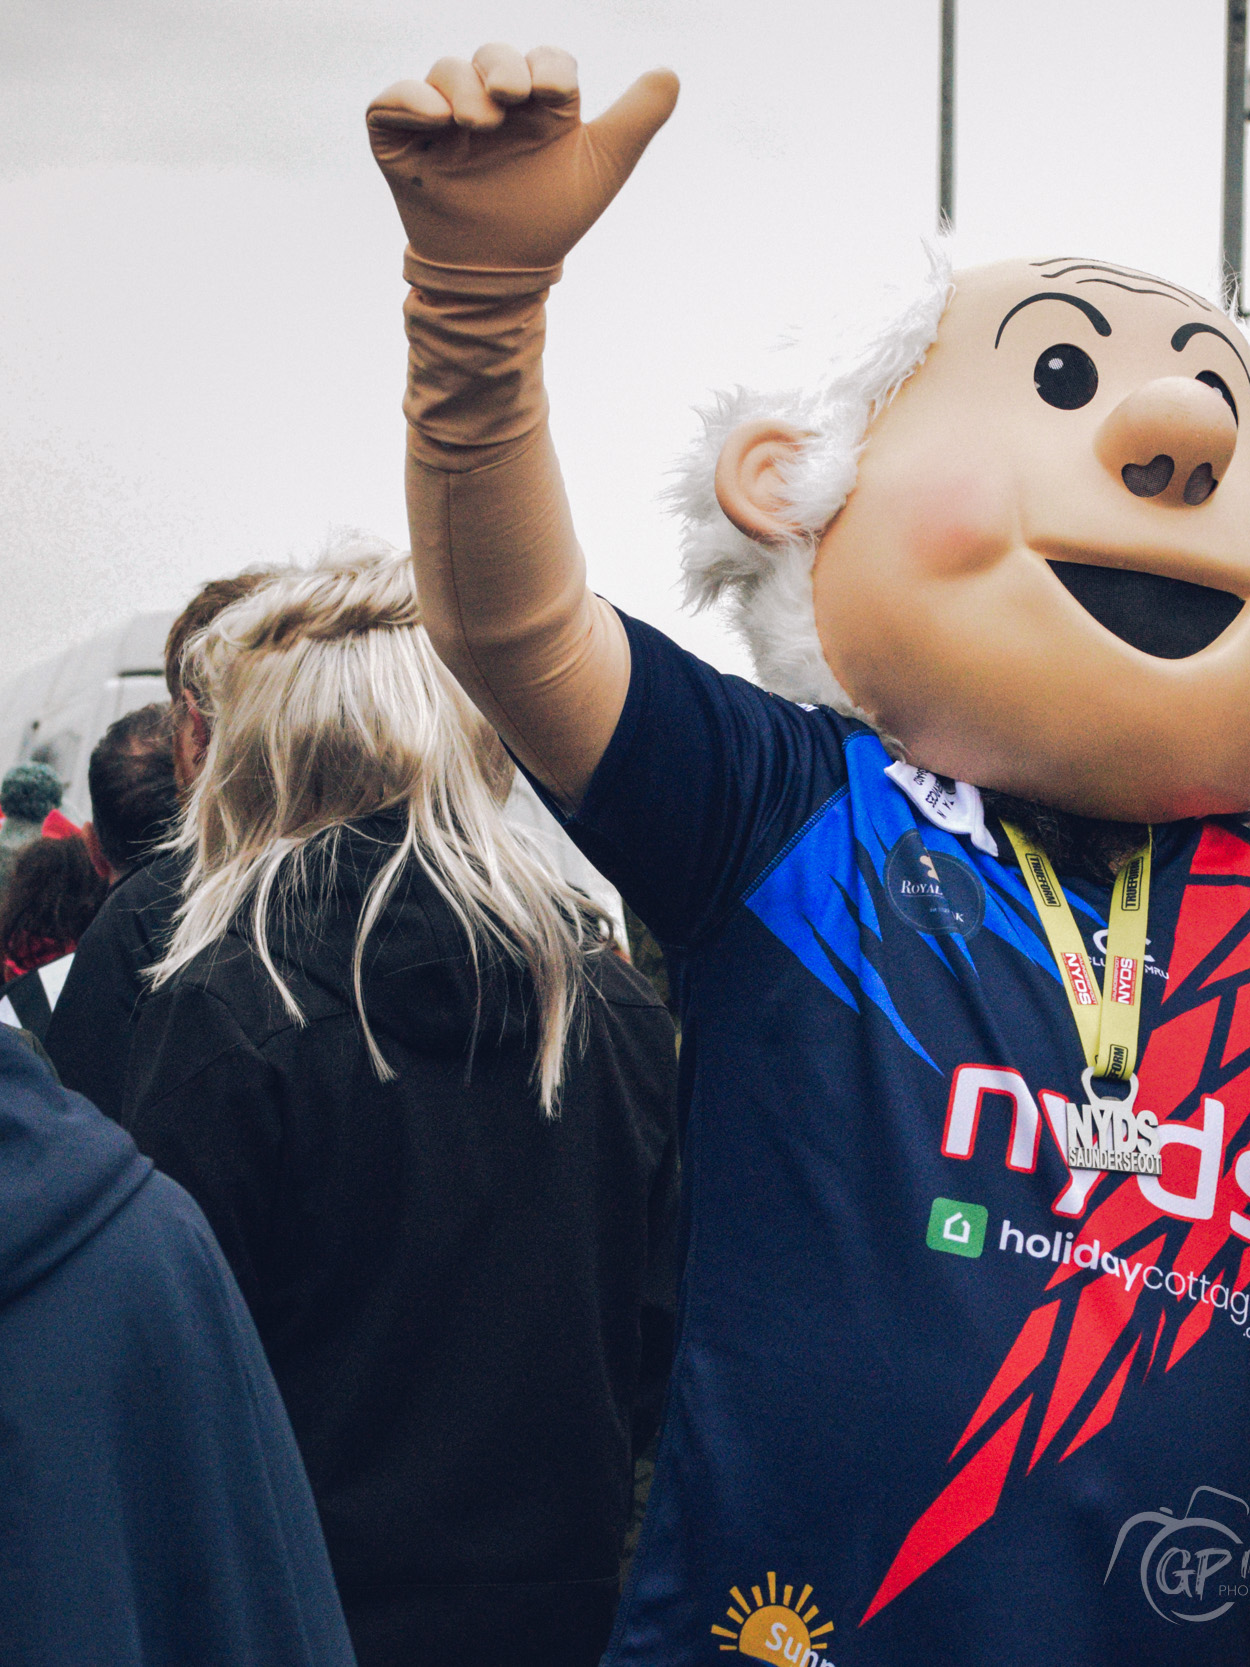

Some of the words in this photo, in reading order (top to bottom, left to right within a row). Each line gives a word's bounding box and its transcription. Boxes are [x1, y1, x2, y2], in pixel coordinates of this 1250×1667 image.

[901, 880, 943, 896] ROYAL
[1029, 856, 1058, 905] TRUEFORM
[1124, 858, 1141, 909] TRUEFORM
[1065, 953, 1092, 1005] NYDS
[1117, 957, 1134, 1005] NYDS
[1066, 1102, 1159, 1154] NYDS
[1068, 1146, 1162, 1174] SAUNDERSFOOT
